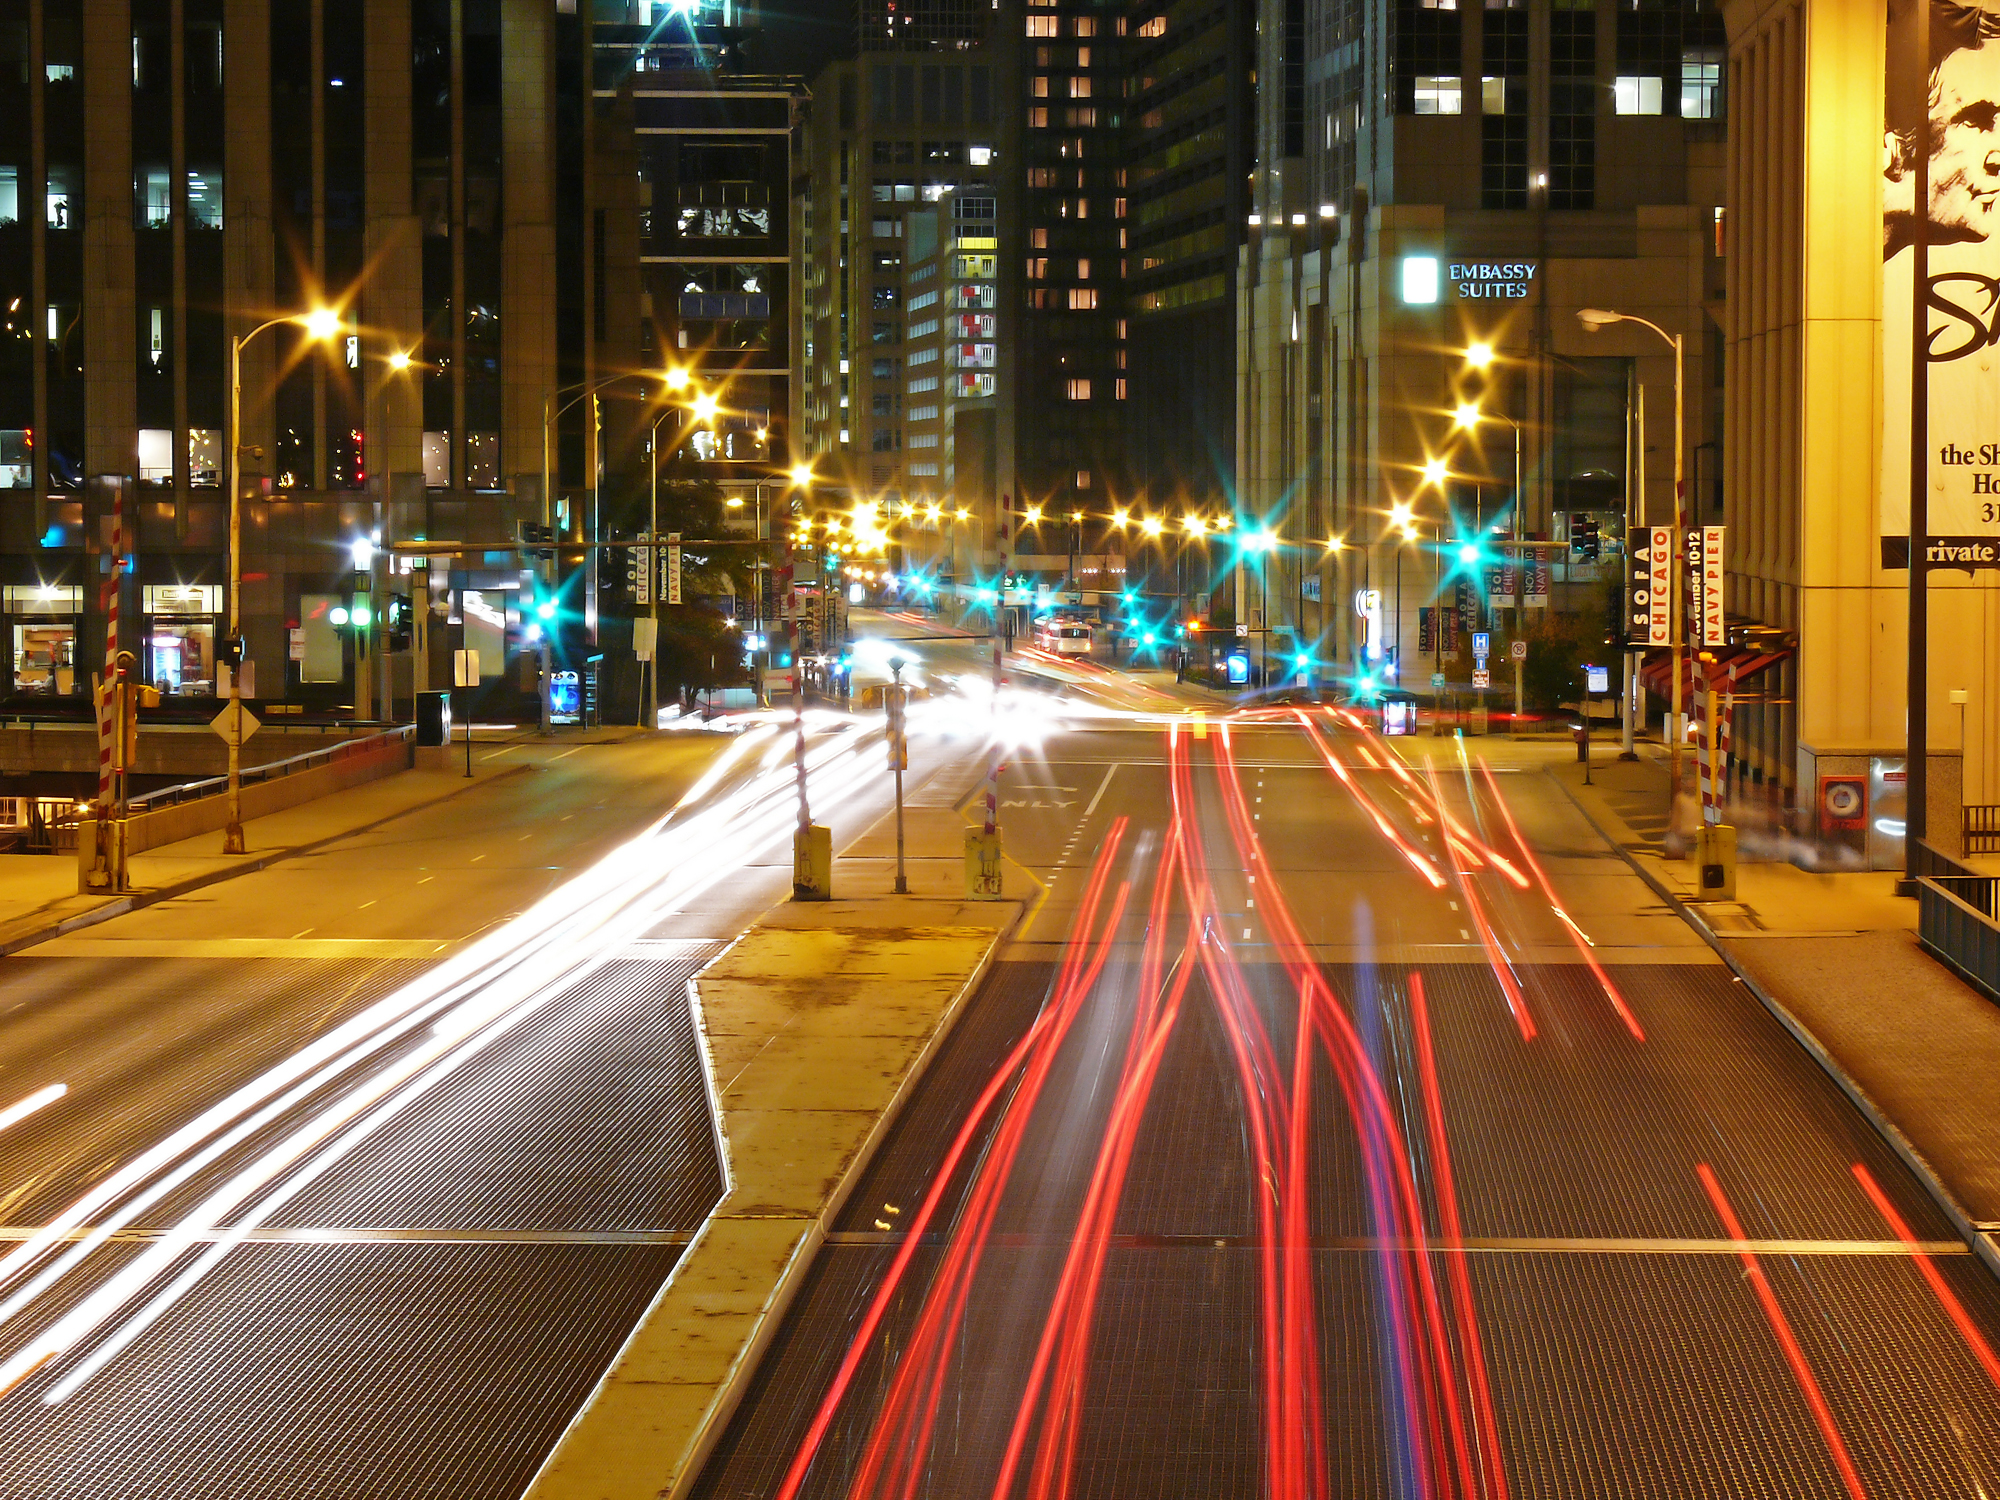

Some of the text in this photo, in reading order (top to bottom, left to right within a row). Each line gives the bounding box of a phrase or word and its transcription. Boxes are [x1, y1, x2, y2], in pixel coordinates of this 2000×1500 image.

[1449, 264, 1536, 280] EMBASSY
[1459, 283, 1527, 298] SUITES
[1925, 271, 2000, 363] S
[1939, 443, 1975, 466] the
[627, 546, 637, 592] SOFA
[1503, 540, 1514, 594] CHICAG
[1926, 540, 1994, 562] rivate
[670, 568, 678, 602] NAVY
[1536, 564, 1545, 594] NAVY
[1633, 547, 1649, 626] SOFA
[1652, 531, 1668, 641] CHICAGO
[1707, 532, 1719, 641] NAVY PIER
[1691, 570, 1701, 640] ovember
[1476, 636, 1486, 648] H
